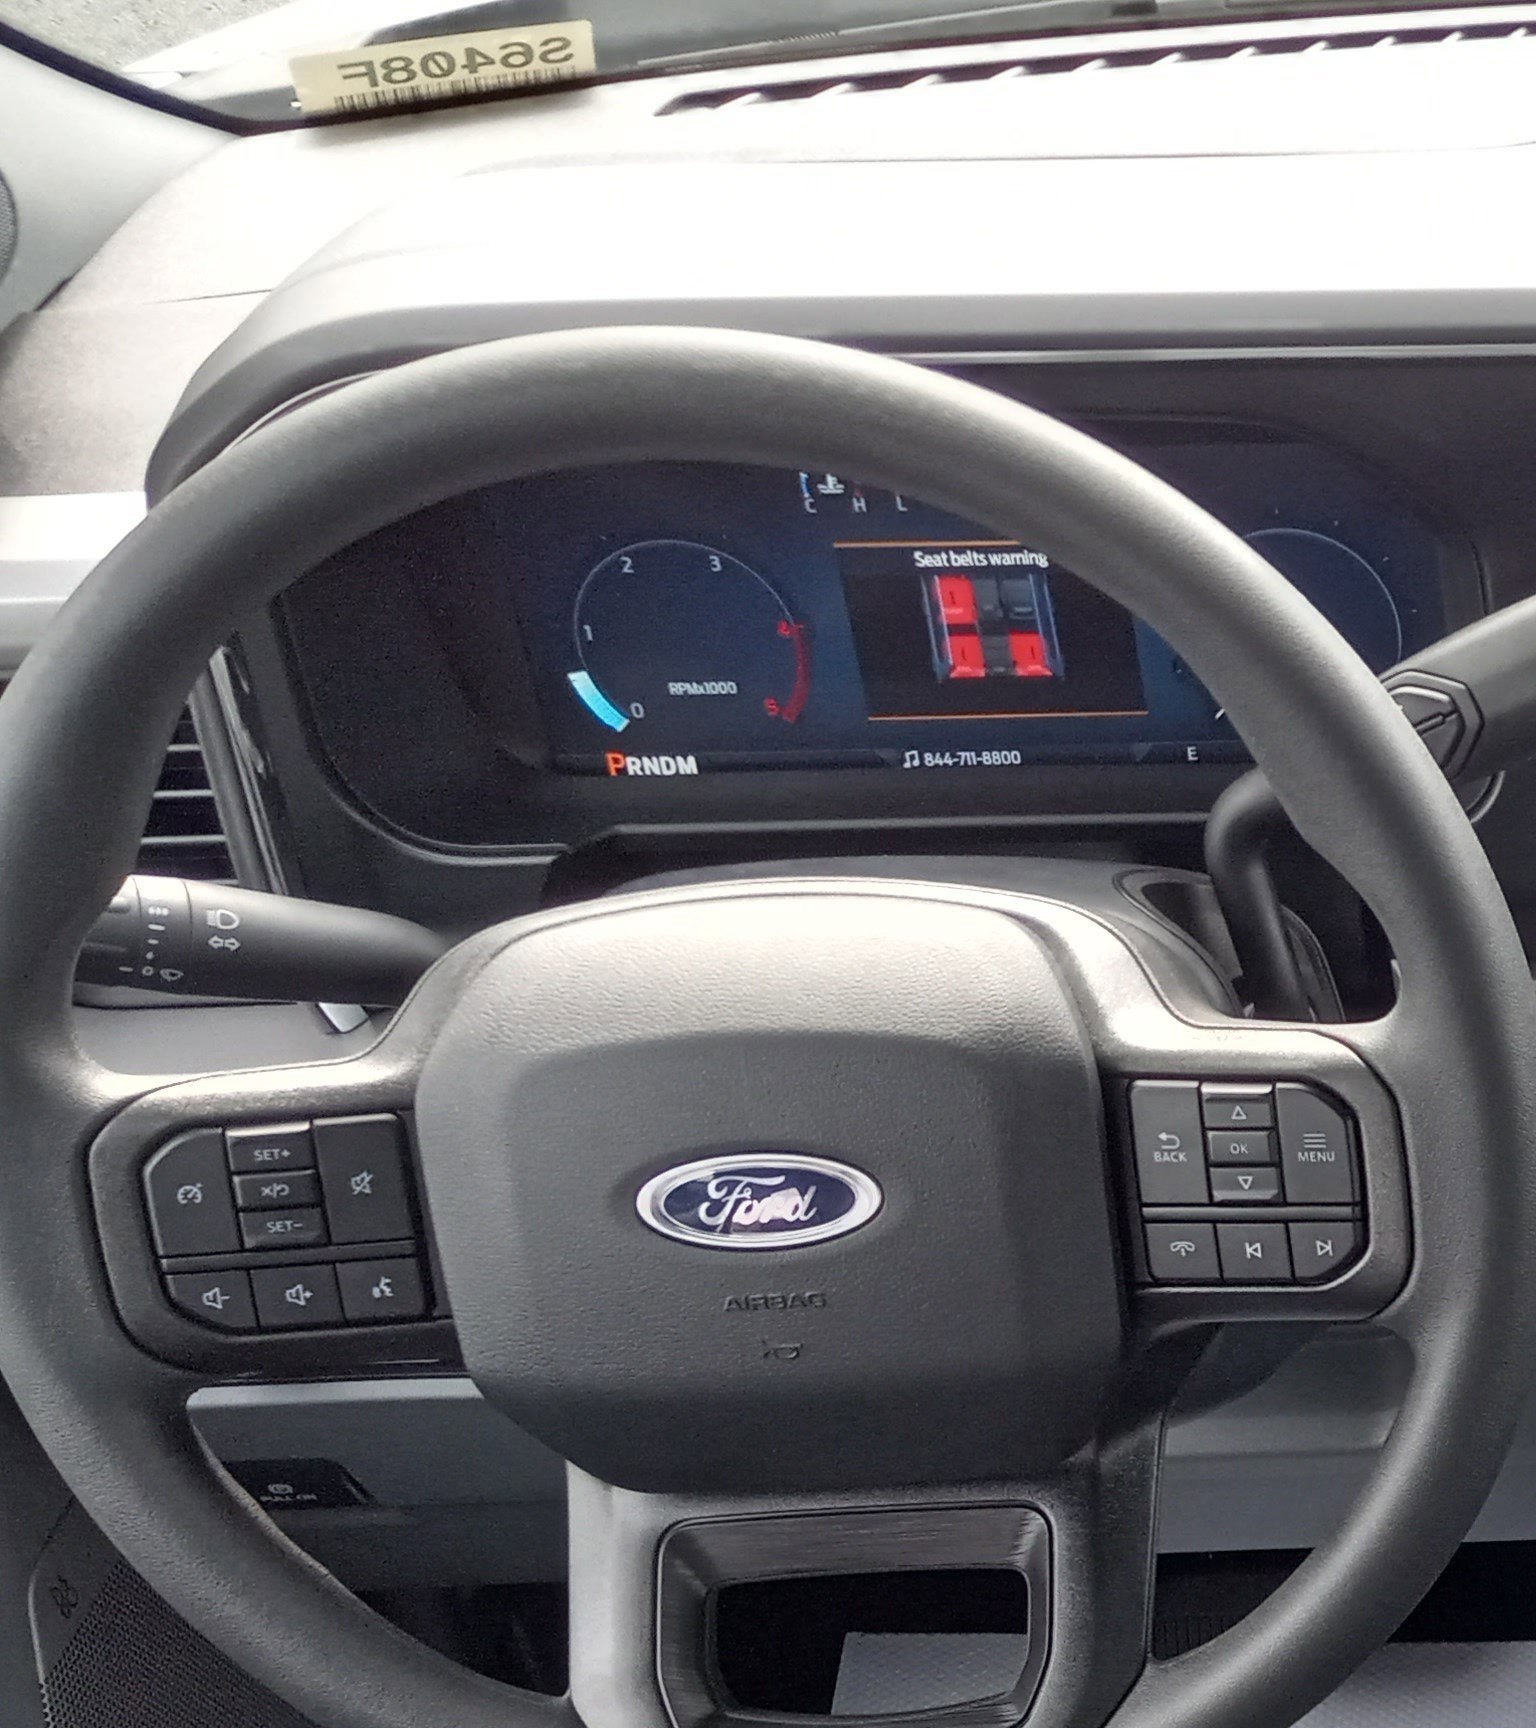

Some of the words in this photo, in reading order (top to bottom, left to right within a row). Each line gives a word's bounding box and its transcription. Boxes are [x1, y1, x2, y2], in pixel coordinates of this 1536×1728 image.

[852, 497, 867, 513] H
[619, 556, 634, 574] 2
[709, 555, 722, 572] 3
[913, 550, 949, 568] Seat
[950, 549, 988, 567] belts
[988, 549, 1049, 569] warning
[583, 624, 593, 642] 1
[630, 702, 645, 719] 0
[924, 750, 1022, 767] 844-711-8800
[1187, 745, 1198, 761] E
[1153, 1151, 1187, 1162] BACK
[1230, 1142, 1249, 1154] OK
[1298, 1151, 1336, 1162] MENU
[699, 1175, 818, 1233] Ford
[723, 1291, 827, 1312] AIRBAG
